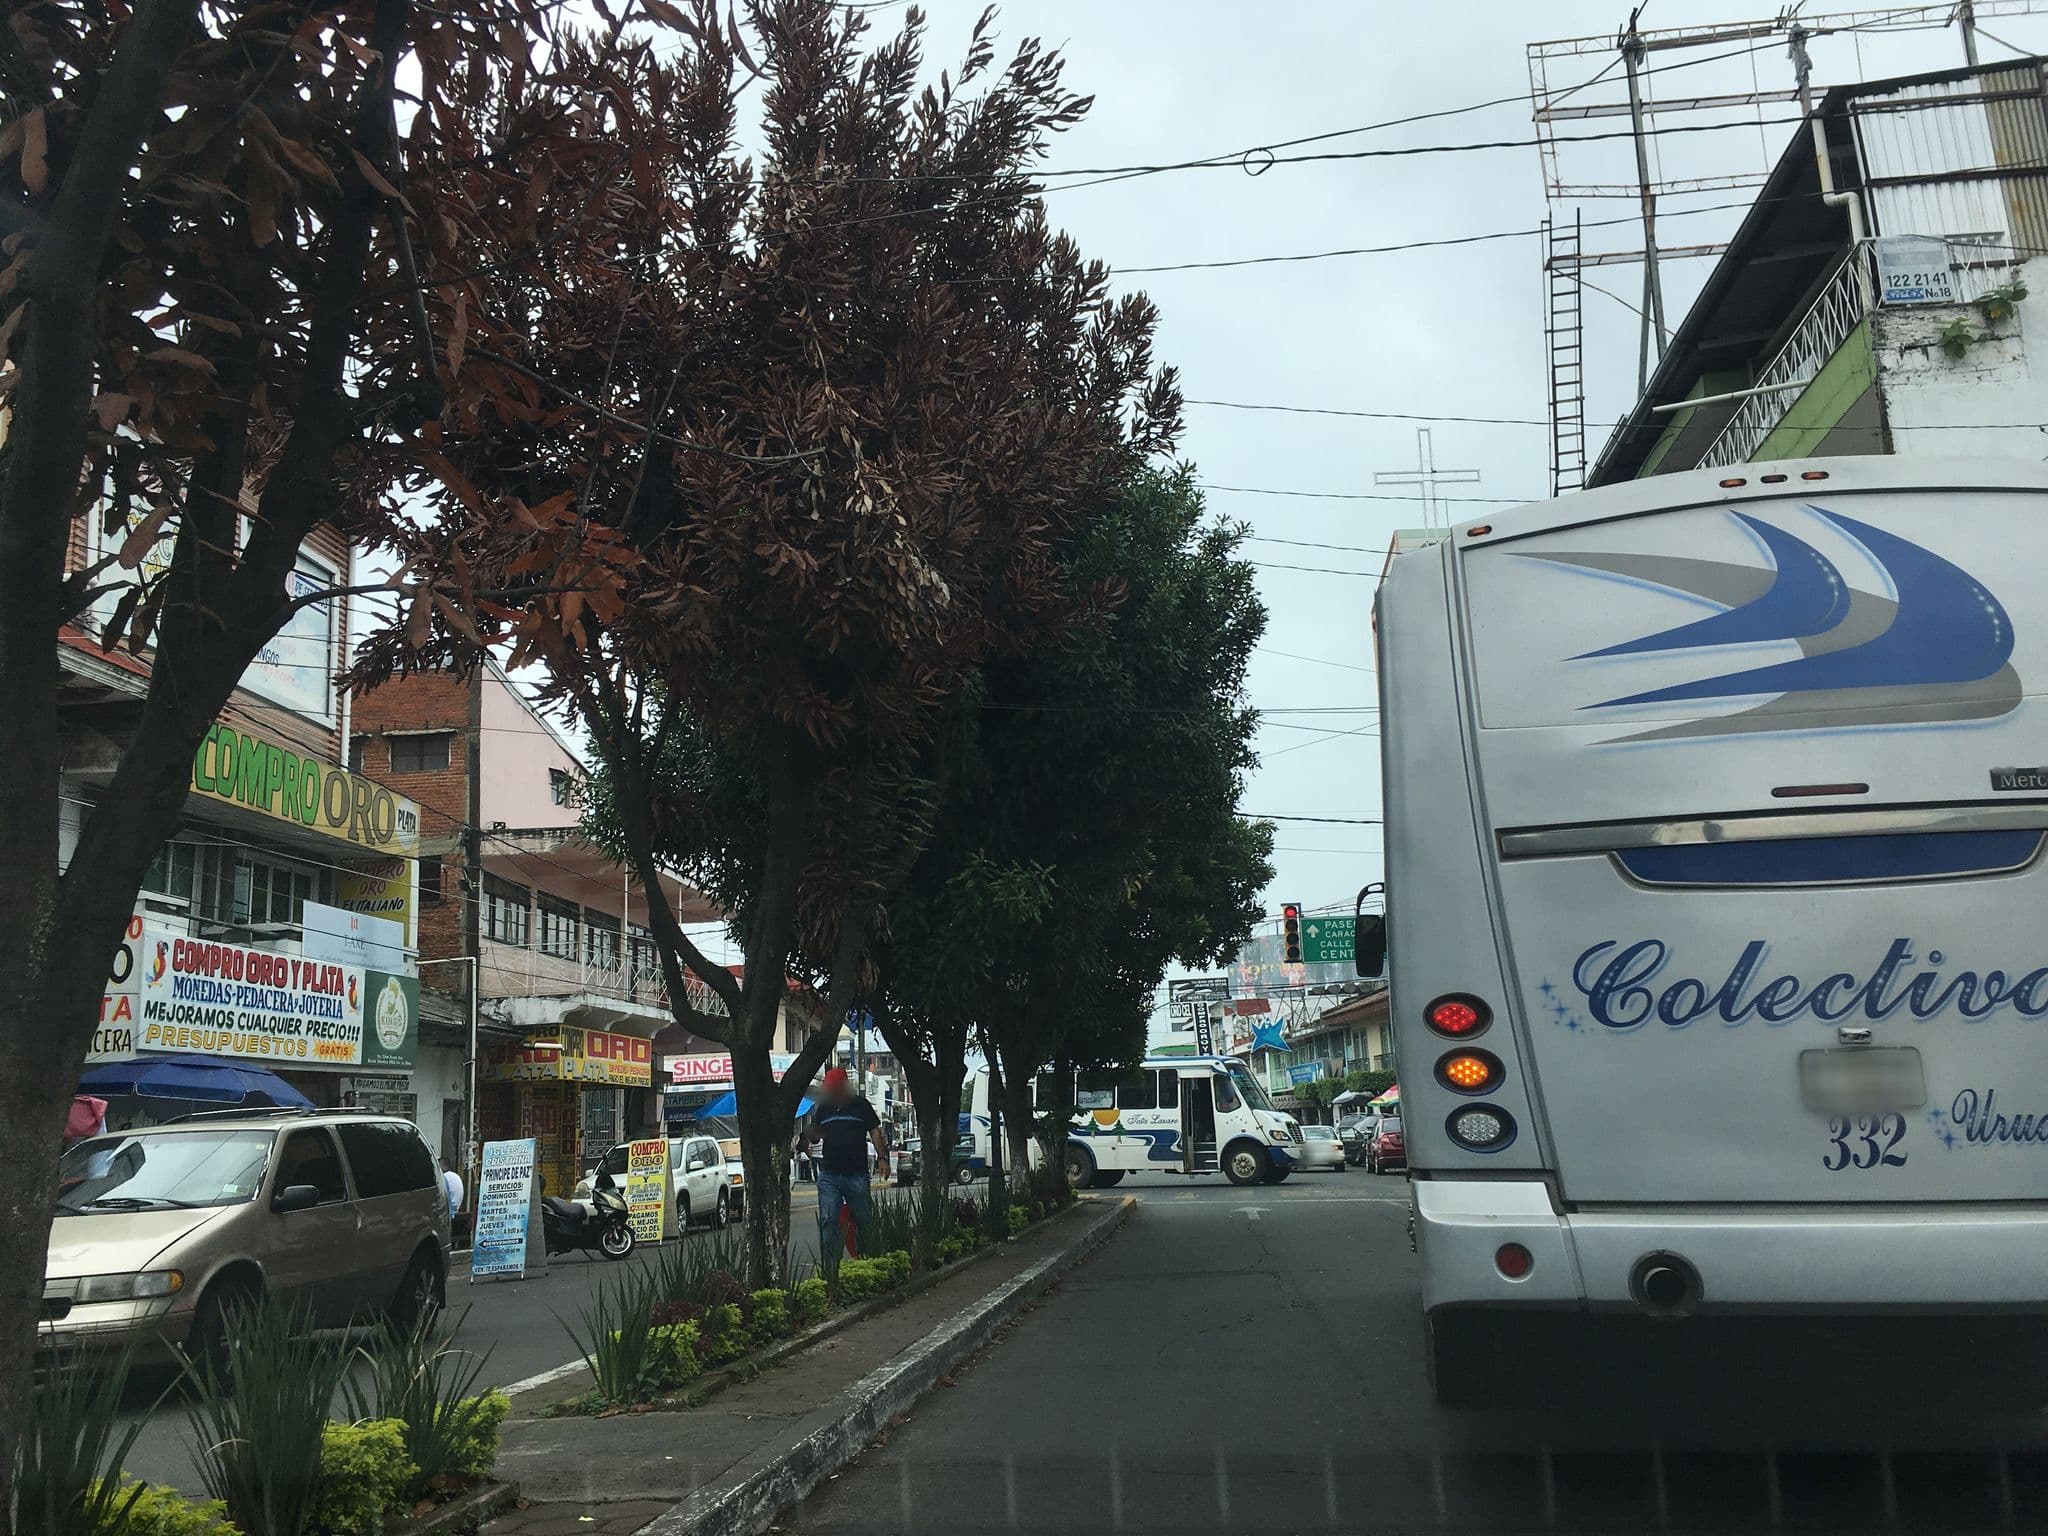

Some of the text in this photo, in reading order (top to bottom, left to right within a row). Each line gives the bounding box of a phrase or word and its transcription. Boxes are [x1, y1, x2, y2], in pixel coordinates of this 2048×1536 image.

[1886, 271, 1948, 287] 122 21 41
[195, 722, 417, 846] COMPRO ORO PLATA
[359, 880, 386, 897] ORO
[1325, 920, 1356, 929] PASE
[1320, 940, 1351, 948] CALLE
[172, 938, 245, 981] COMPRO
[245, 951, 289, 989] ORO
[290, 959, 301, 990] Y
[302, 961, 345, 997] PLATA
[299, 993, 344, 1019] JOYERIA
[143, 999, 361, 1042] MEJORAMOS CUALQUIER PRECIO!!!
[89, 1028, 132, 1053] CERA
[144, 1023, 349, 1058] PRESUPUESTOS GRATIS
[587, 1030, 652, 1064] ORO
[561, 1057, 609, 1082] PLATA
[673, 1058, 733, 1076] SINGE
[665, 1094, 706, 1105] STAMBRES
[631, 1140, 666, 1157] COMPRO
[1823, 1112, 1908, 1171] 332
[488, 1143, 529, 1157] IGLESIA
[485, 1153, 531, 1168] CRISTIANA
[631, 1154, 664, 1168] ORO
[511, 1166, 519, 1180] DE
[643, 1176, 649, 1184] Y
[488, 1182, 524, 1192] SERVICIOS:
[482, 1191, 519, 1201] DOMINGOS:
[481, 1207, 510, 1216] MARTES:
[636, 1218, 659, 1226] MEJOR
[648, 1224, 661, 1232] DEL
[635, 1231, 658, 1240] RCADO
